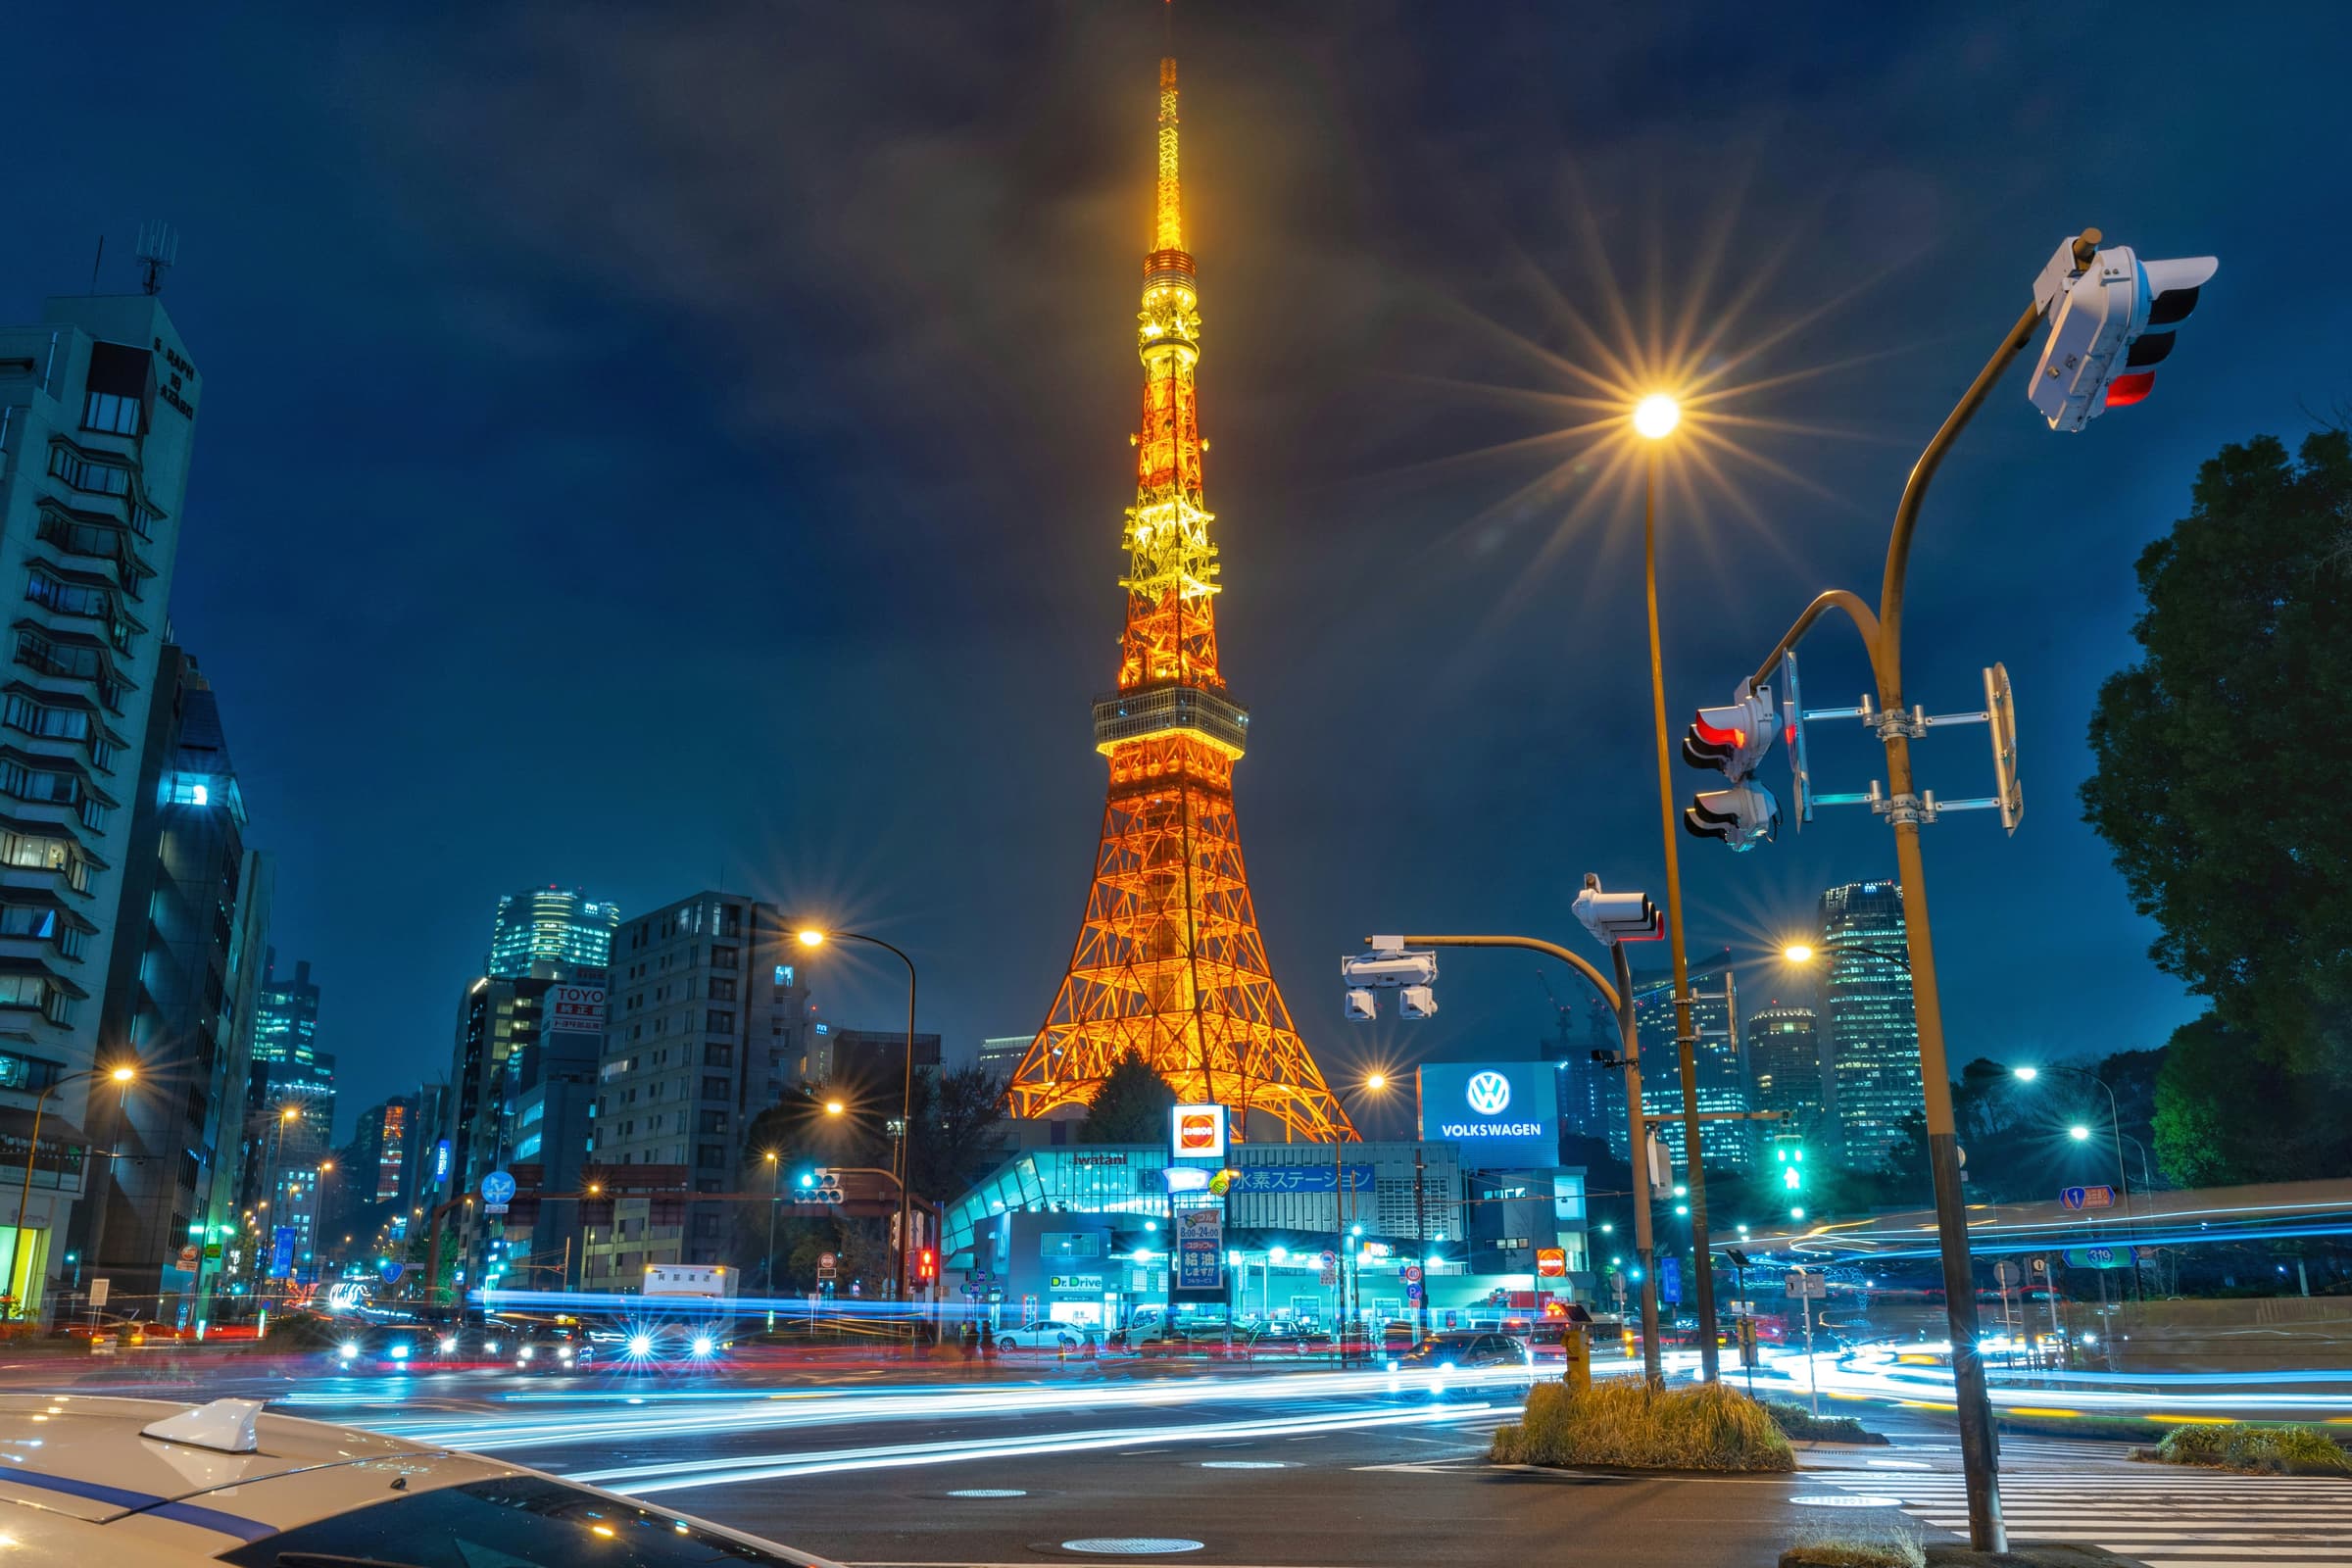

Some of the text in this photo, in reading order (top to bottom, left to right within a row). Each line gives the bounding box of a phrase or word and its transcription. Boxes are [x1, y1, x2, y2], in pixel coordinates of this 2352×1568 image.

[154, 336, 194, 381] SRAPH
[558, 987, 605, 1003] TOYO
[1442, 1123, 1542, 1137] VOLKSWAGEN
[1074, 1152, 1128, 1164] iwatani
[1234, 1170, 1371, 1190] 水素ステーション
[2072, 1191, 2079, 1204] 1
[1185, 1251, 1215, 1266] 給油
[2089, 1250, 2112, 1263] 319
[1051, 1276, 1102, 1288] Dr. Drive
